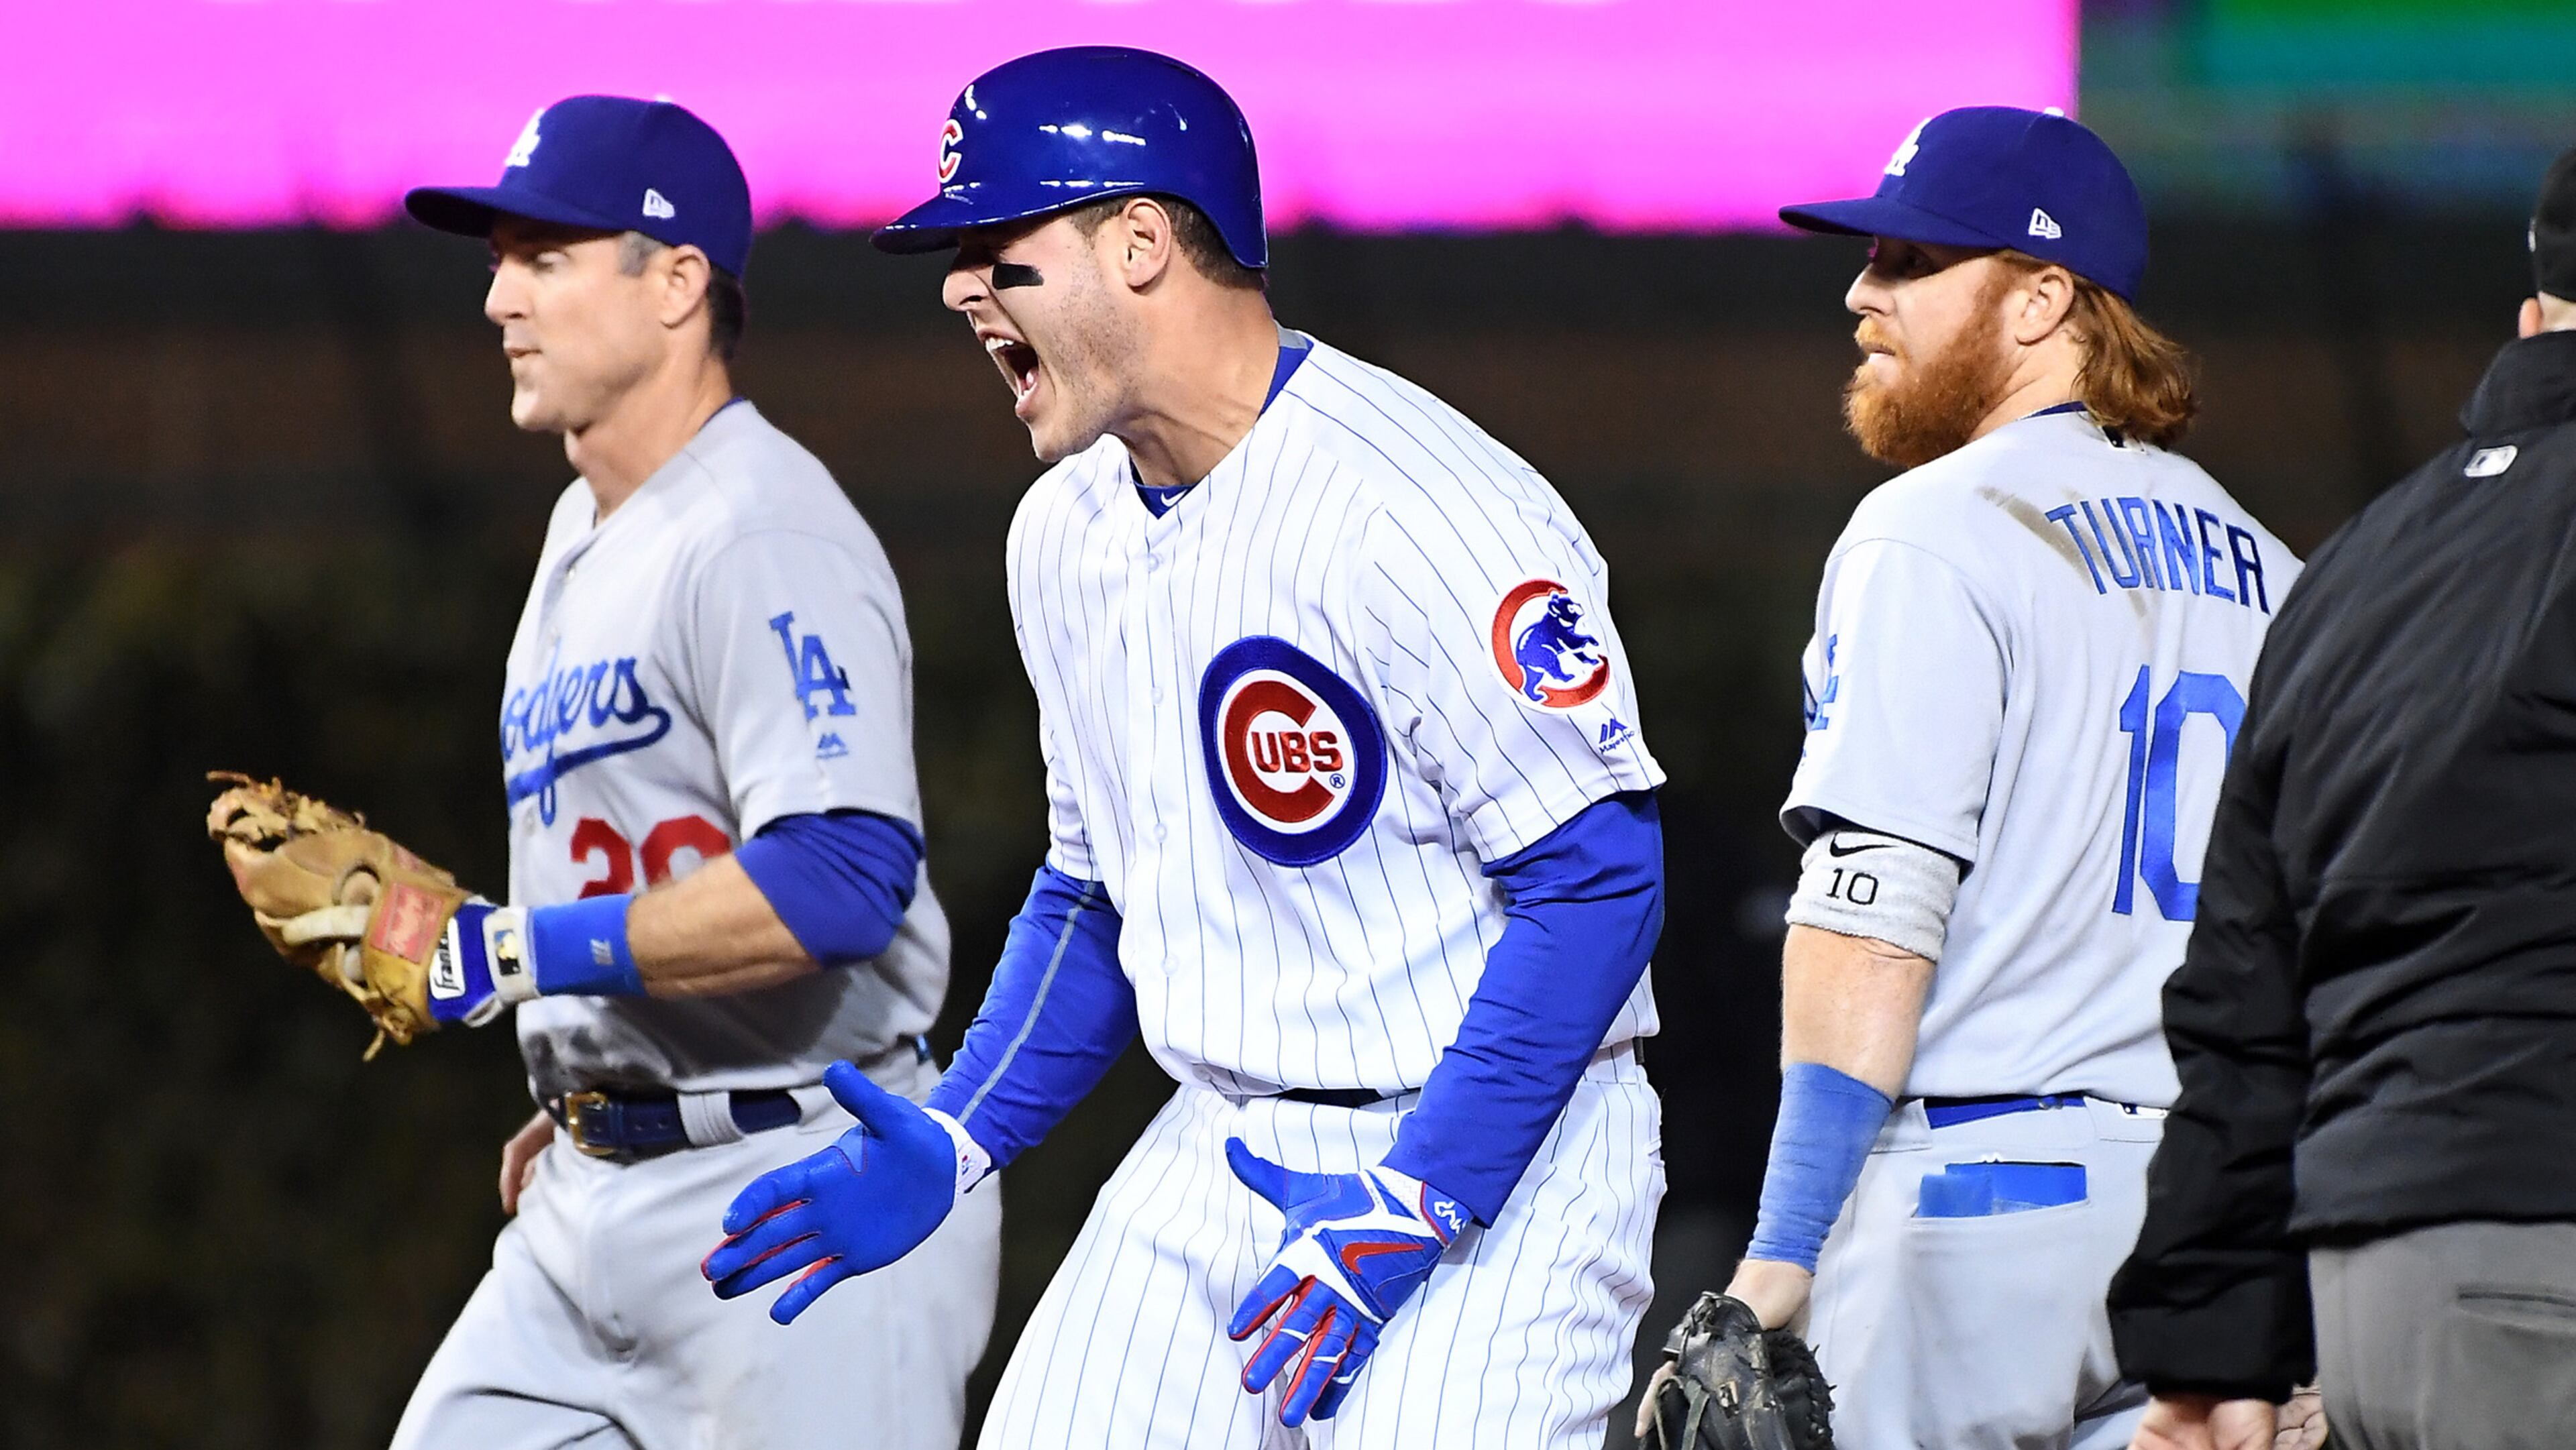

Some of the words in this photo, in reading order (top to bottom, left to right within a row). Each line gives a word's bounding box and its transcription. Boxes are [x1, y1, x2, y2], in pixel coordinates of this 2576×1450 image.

[938, 119, 964, 184] C
[2045, 497, 2271, 614] TURNER
[769, 611, 856, 721] LA
[500, 635, 671, 828] odgers
[1224, 680, 1344, 824] CUBS
[2112, 664, 2246, 922] 10
[1826, 868, 1879, 905] 10
